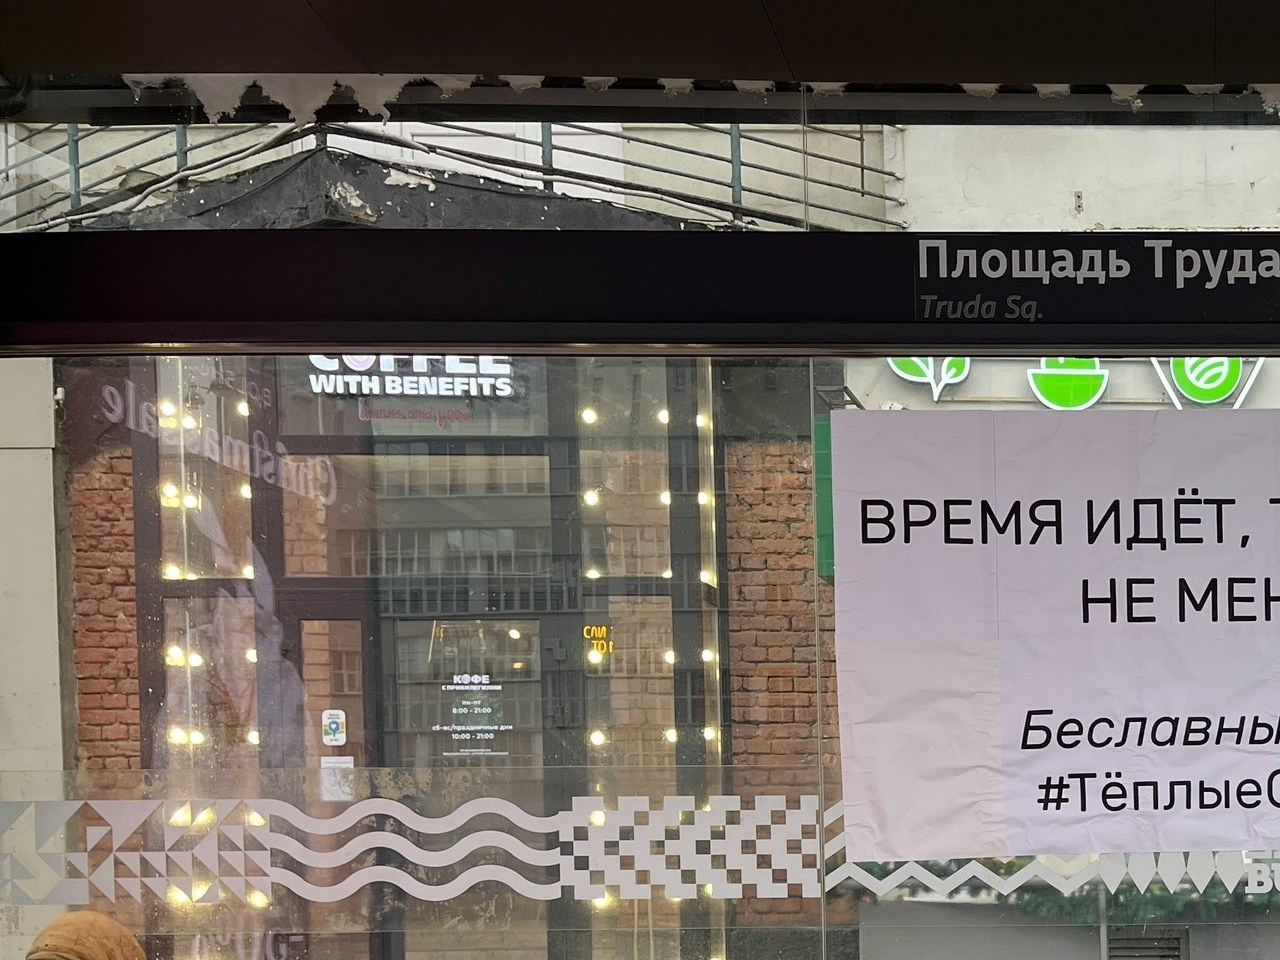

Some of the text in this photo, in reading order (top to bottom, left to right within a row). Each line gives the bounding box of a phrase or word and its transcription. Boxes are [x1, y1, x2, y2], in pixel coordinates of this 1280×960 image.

[919, 239, 1131, 285] Площадь
[920, 294, 1043, 322] Truda Sq.
[309, 374, 513, 396] WITH BENEFITS
[860, 499, 1063, 546] ВРЕМЯ
[1086, 487, 1250, 551] ИДЁТ,
[1081, 577, 1157, 624] НЕ
[453, 674, 490, 684] КОФЕ
